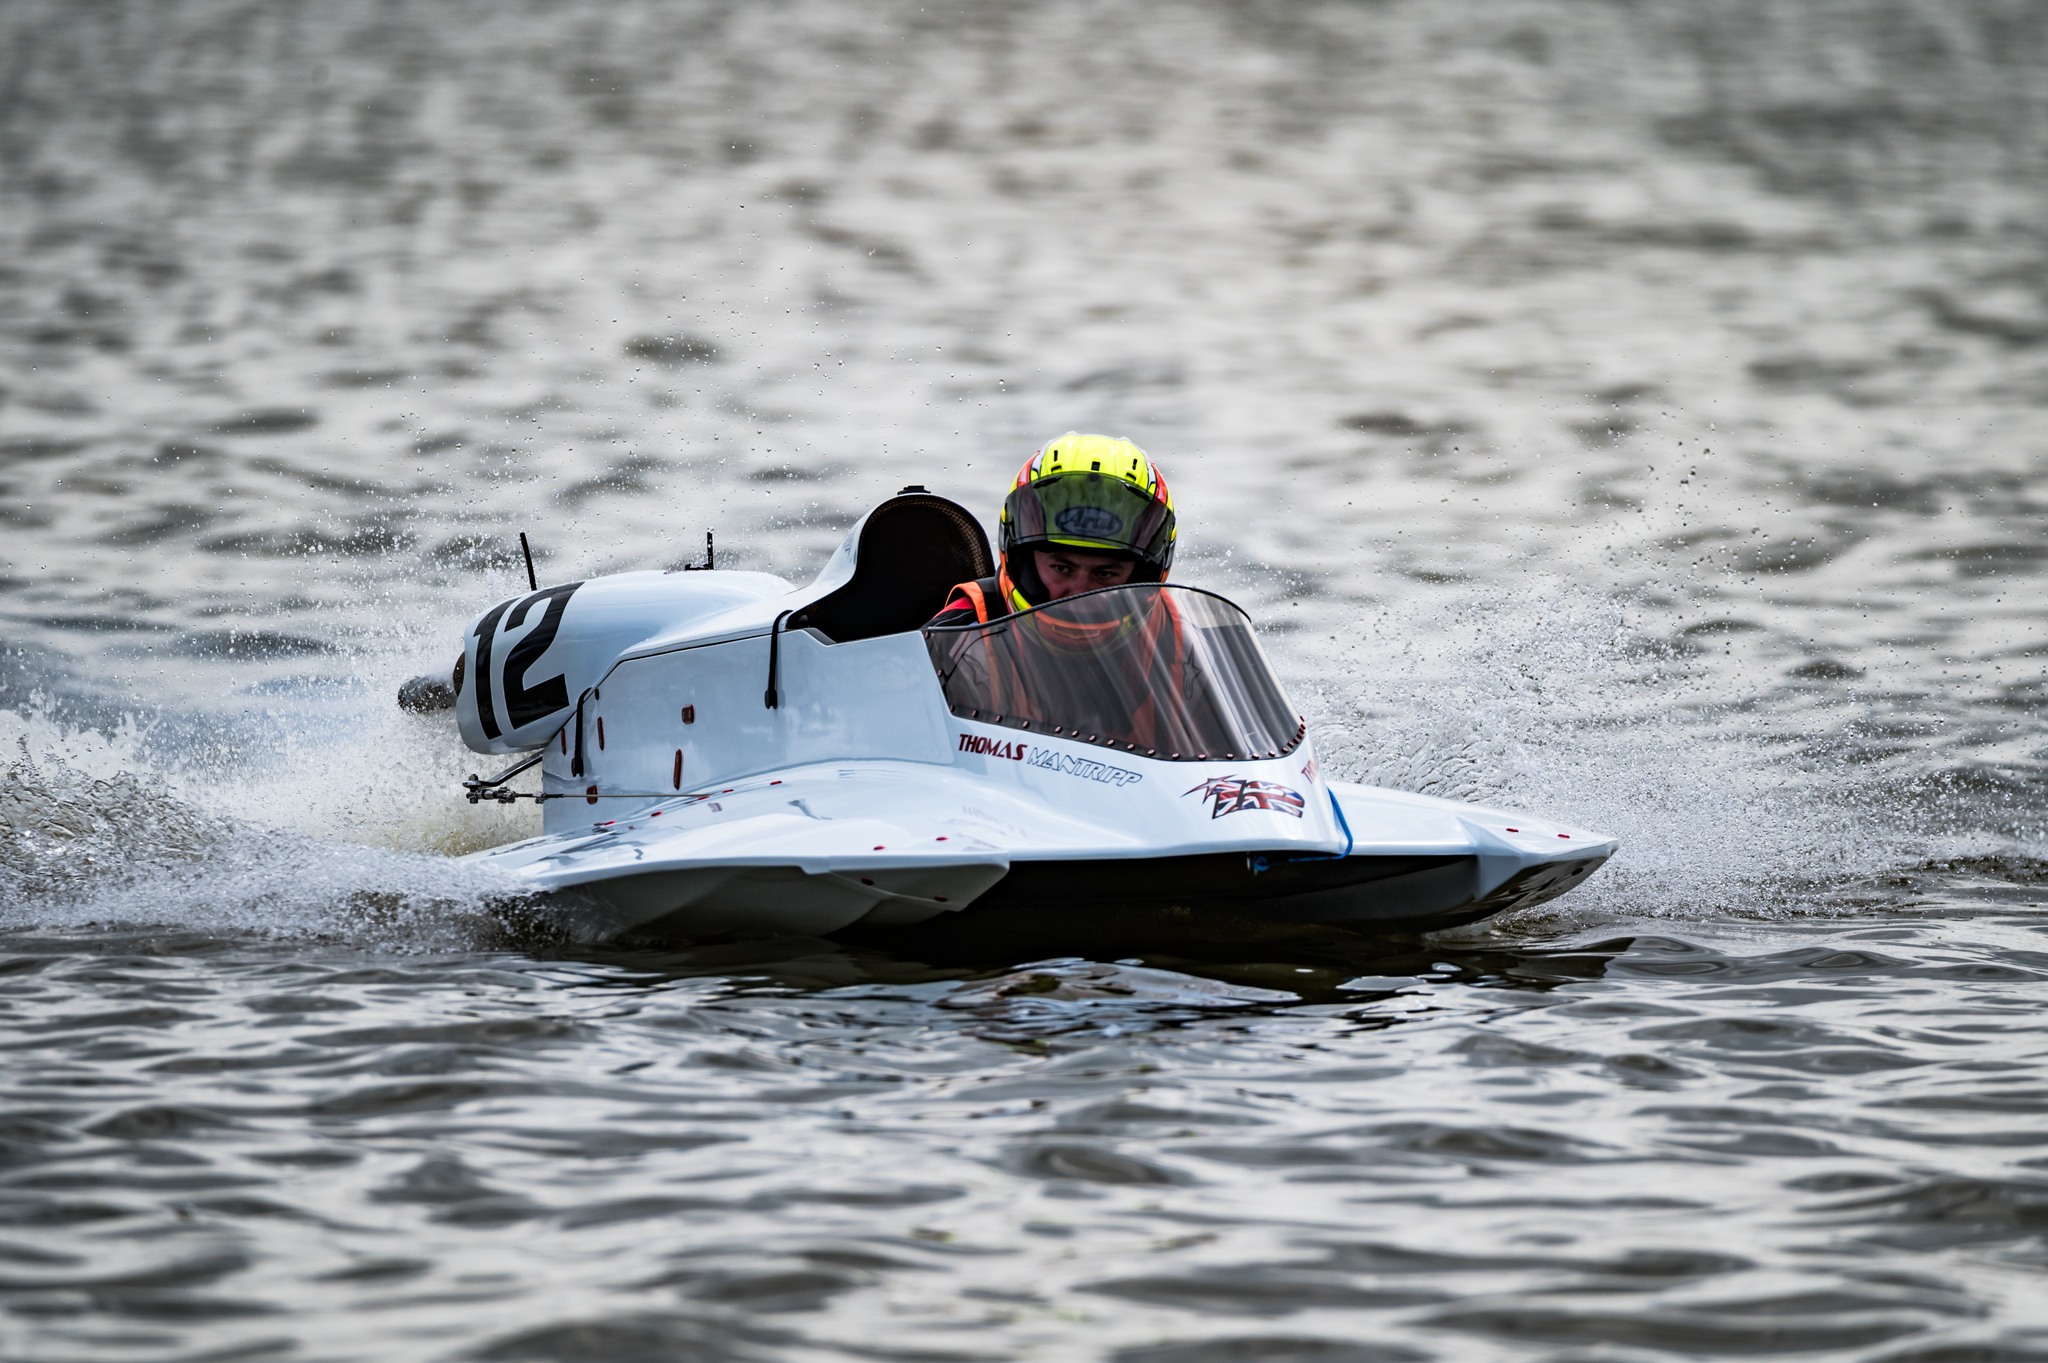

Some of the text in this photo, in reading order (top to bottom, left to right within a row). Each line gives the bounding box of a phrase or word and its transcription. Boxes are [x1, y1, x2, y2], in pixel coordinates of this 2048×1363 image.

[472, 581, 586, 740] 12
[959, 733, 1142, 786] THOMAS MANTRIPP
